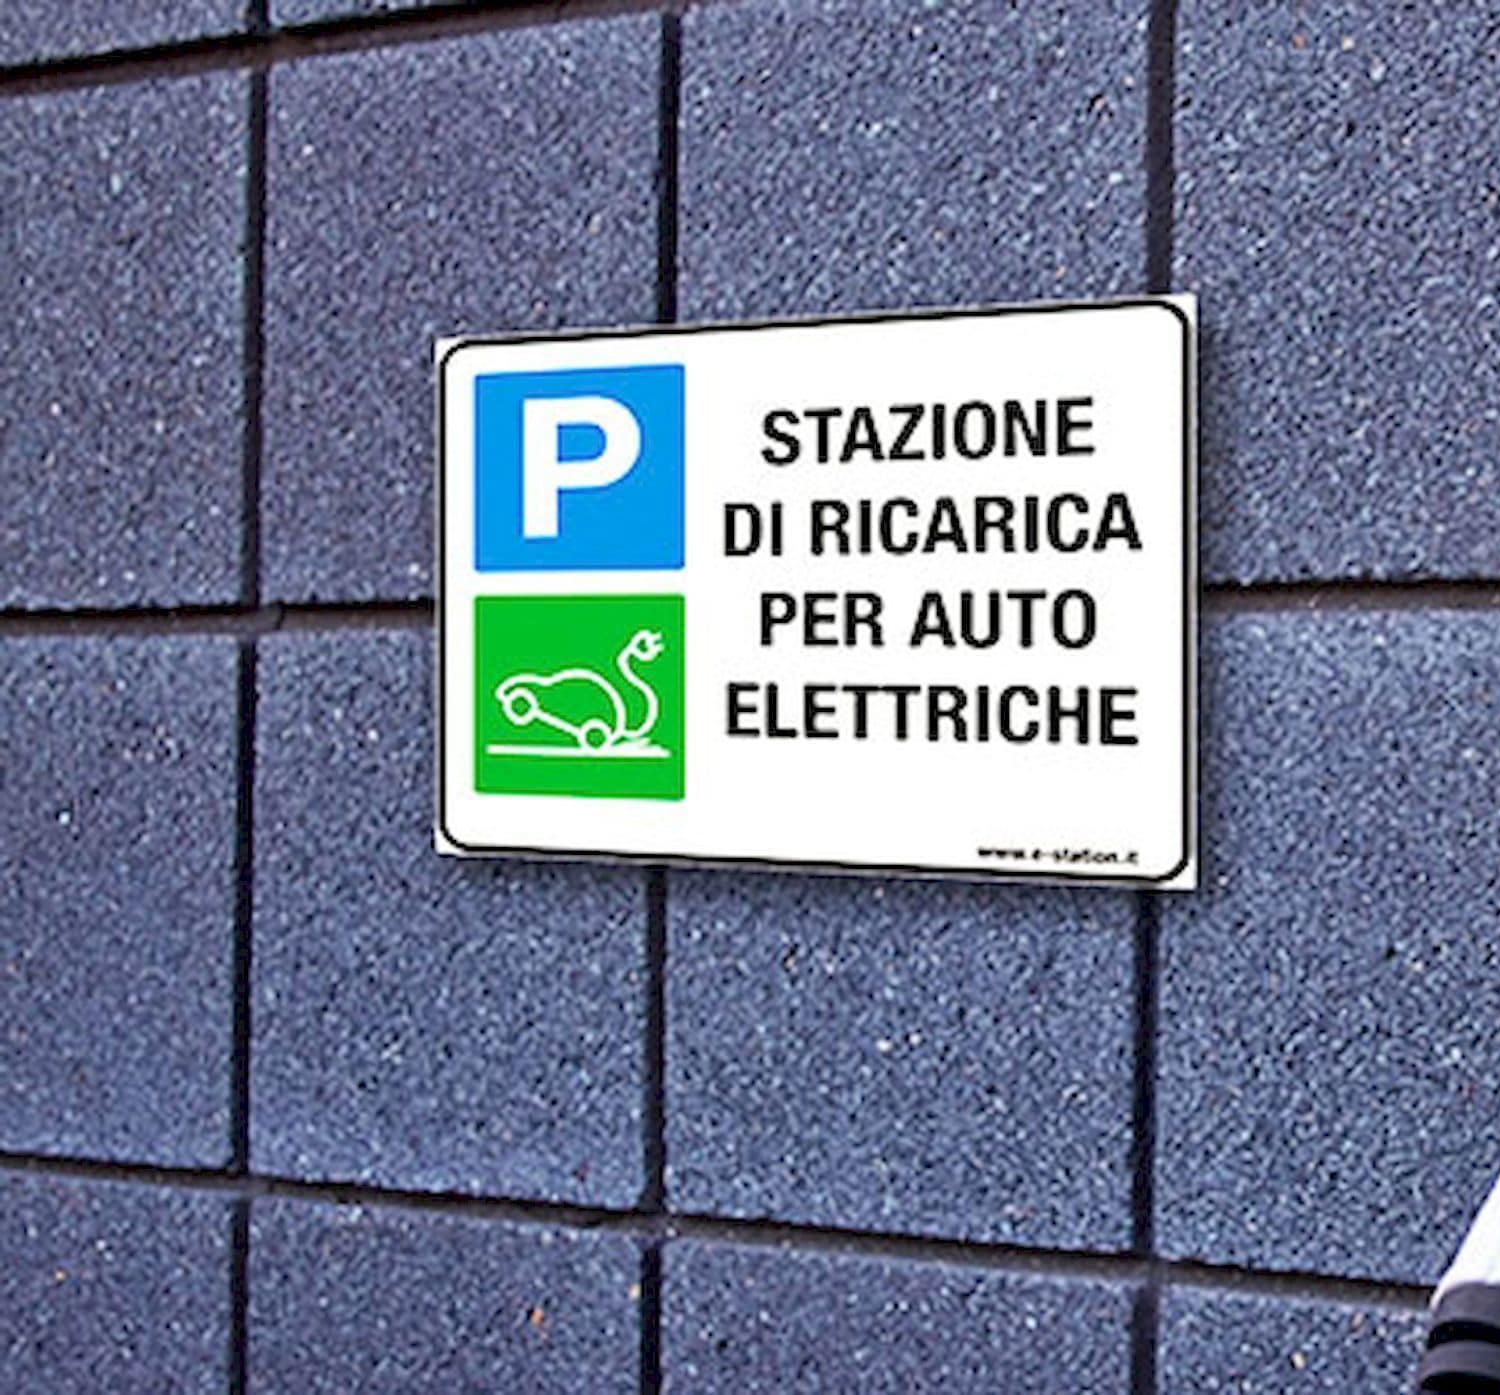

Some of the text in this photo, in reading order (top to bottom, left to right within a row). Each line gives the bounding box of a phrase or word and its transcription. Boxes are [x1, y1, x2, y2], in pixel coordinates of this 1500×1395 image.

[761, 396, 1096, 467] STAZIONE
[523, 396, 641, 538] P
[724, 492, 1143, 557] DI RICARICA
[760, 589, 1097, 649] PER AUTO
[727, 682, 1140, 746] ELETTRICHE
[977, 846, 1139, 865] www.e-station.it
